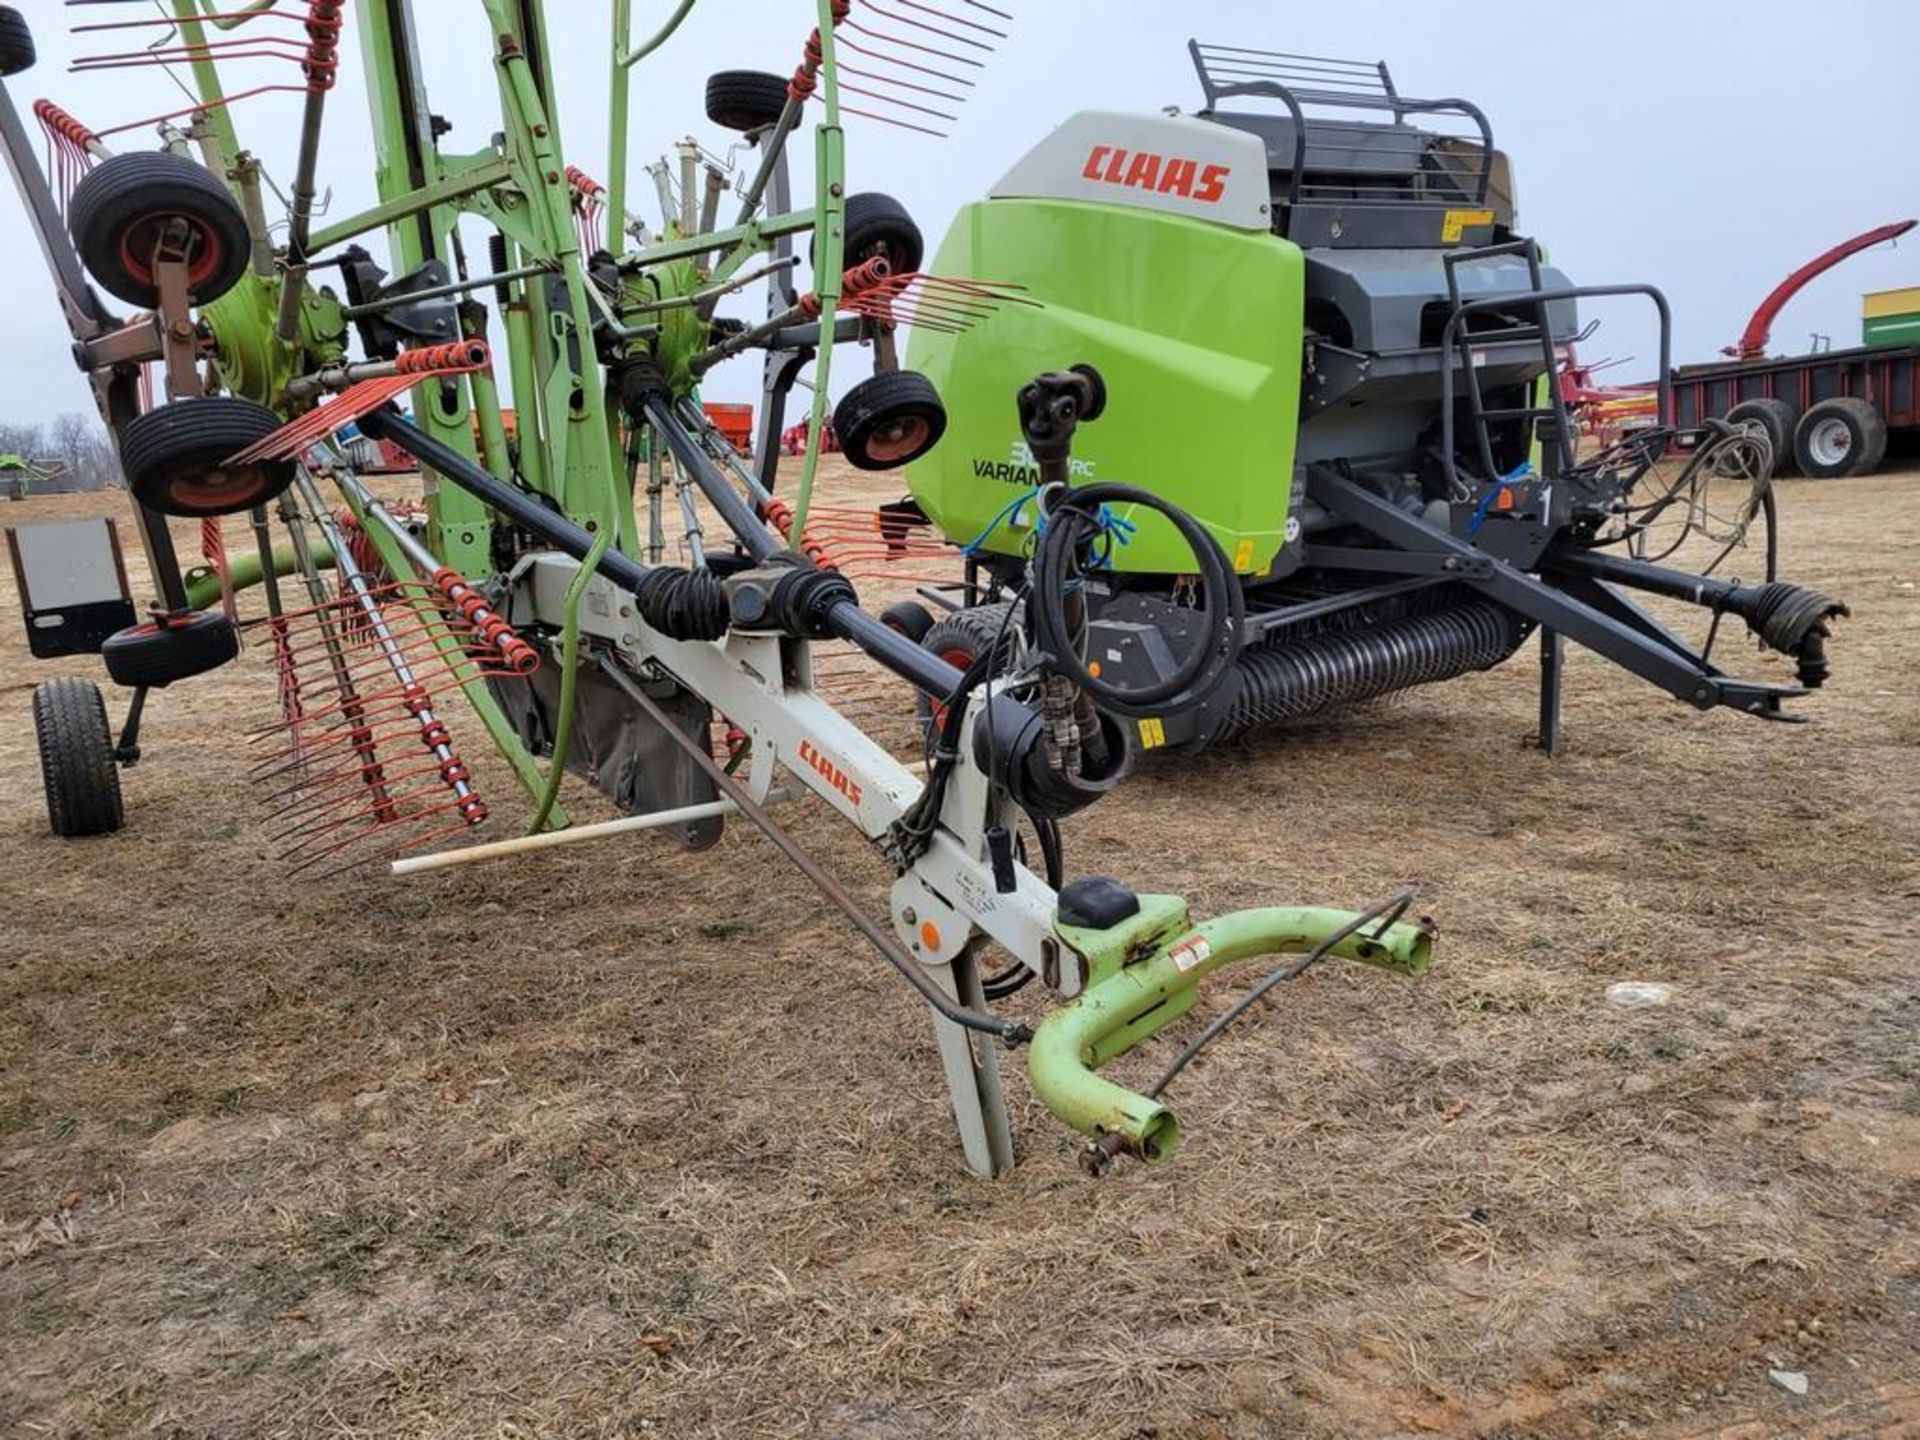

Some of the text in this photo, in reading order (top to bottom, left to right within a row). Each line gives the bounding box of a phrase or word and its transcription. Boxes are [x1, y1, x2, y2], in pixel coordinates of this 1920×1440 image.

[1082, 146, 1231, 203] CLAAS
[972, 459, 1041, 486] VARIAN
[799, 739, 863, 807] CLAAS
